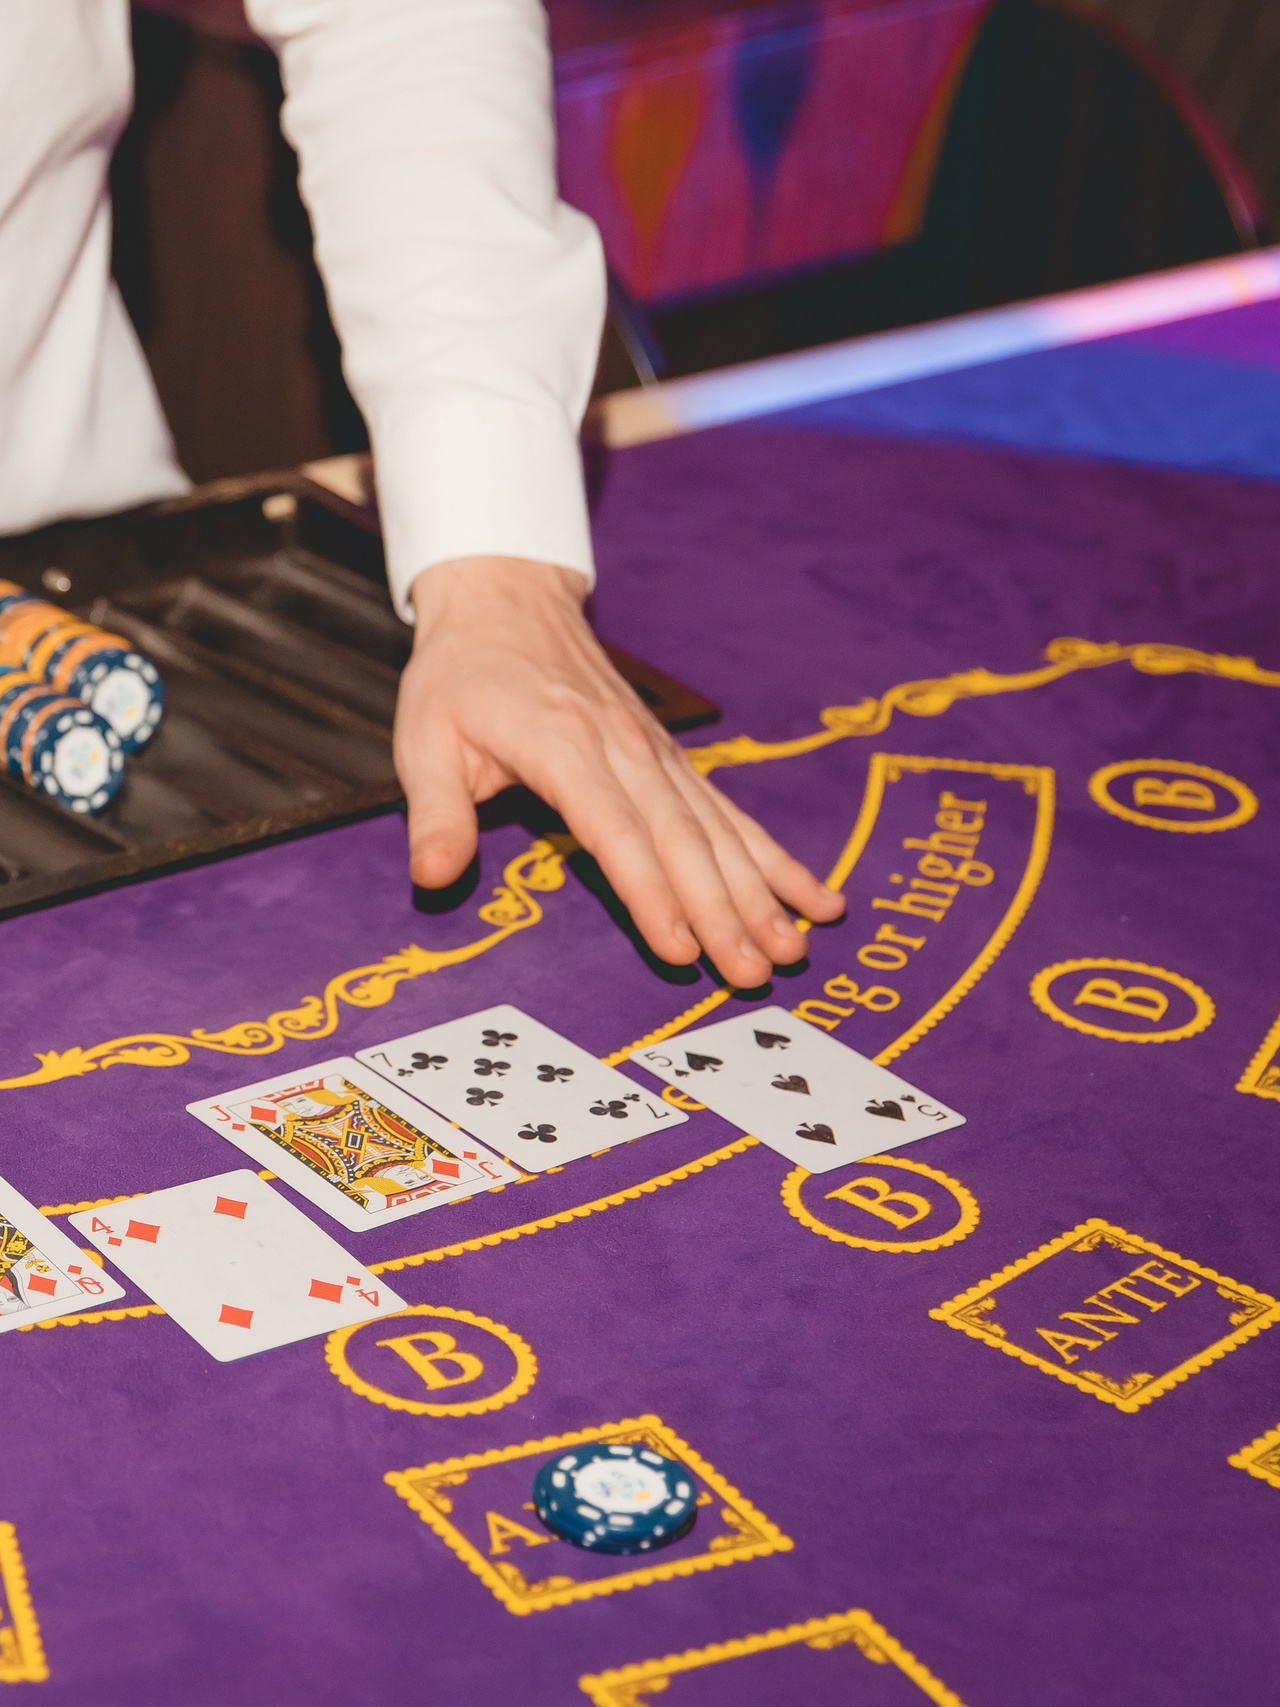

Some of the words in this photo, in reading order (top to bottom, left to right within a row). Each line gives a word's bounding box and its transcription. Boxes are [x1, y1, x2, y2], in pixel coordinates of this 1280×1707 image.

[1134, 778, 1215, 811] B
[872, 791, 995, 922] higher
[857, 924, 927, 970] or
[791, 974, 901, 1031] ng
[1074, 978, 1168, 1022] B
[370, 1052, 393, 1068] 7
[644, 1051, 673, 1069] 5
[209, 1104, 232, 1122] J
[645, 1102, 670, 1120] 7
[917, 1103, 949, 1122] 5
[477, 1160, 502, 1181] J
[825, 1177, 933, 1231] B
[91, 1216, 115, 1235] 4
[76, 1276, 105, 1296] Q
[356, 1288, 380, 1308] 4
[1035, 1260, 1203, 1365] ANTE
[376, 1331, 484, 1390] B
